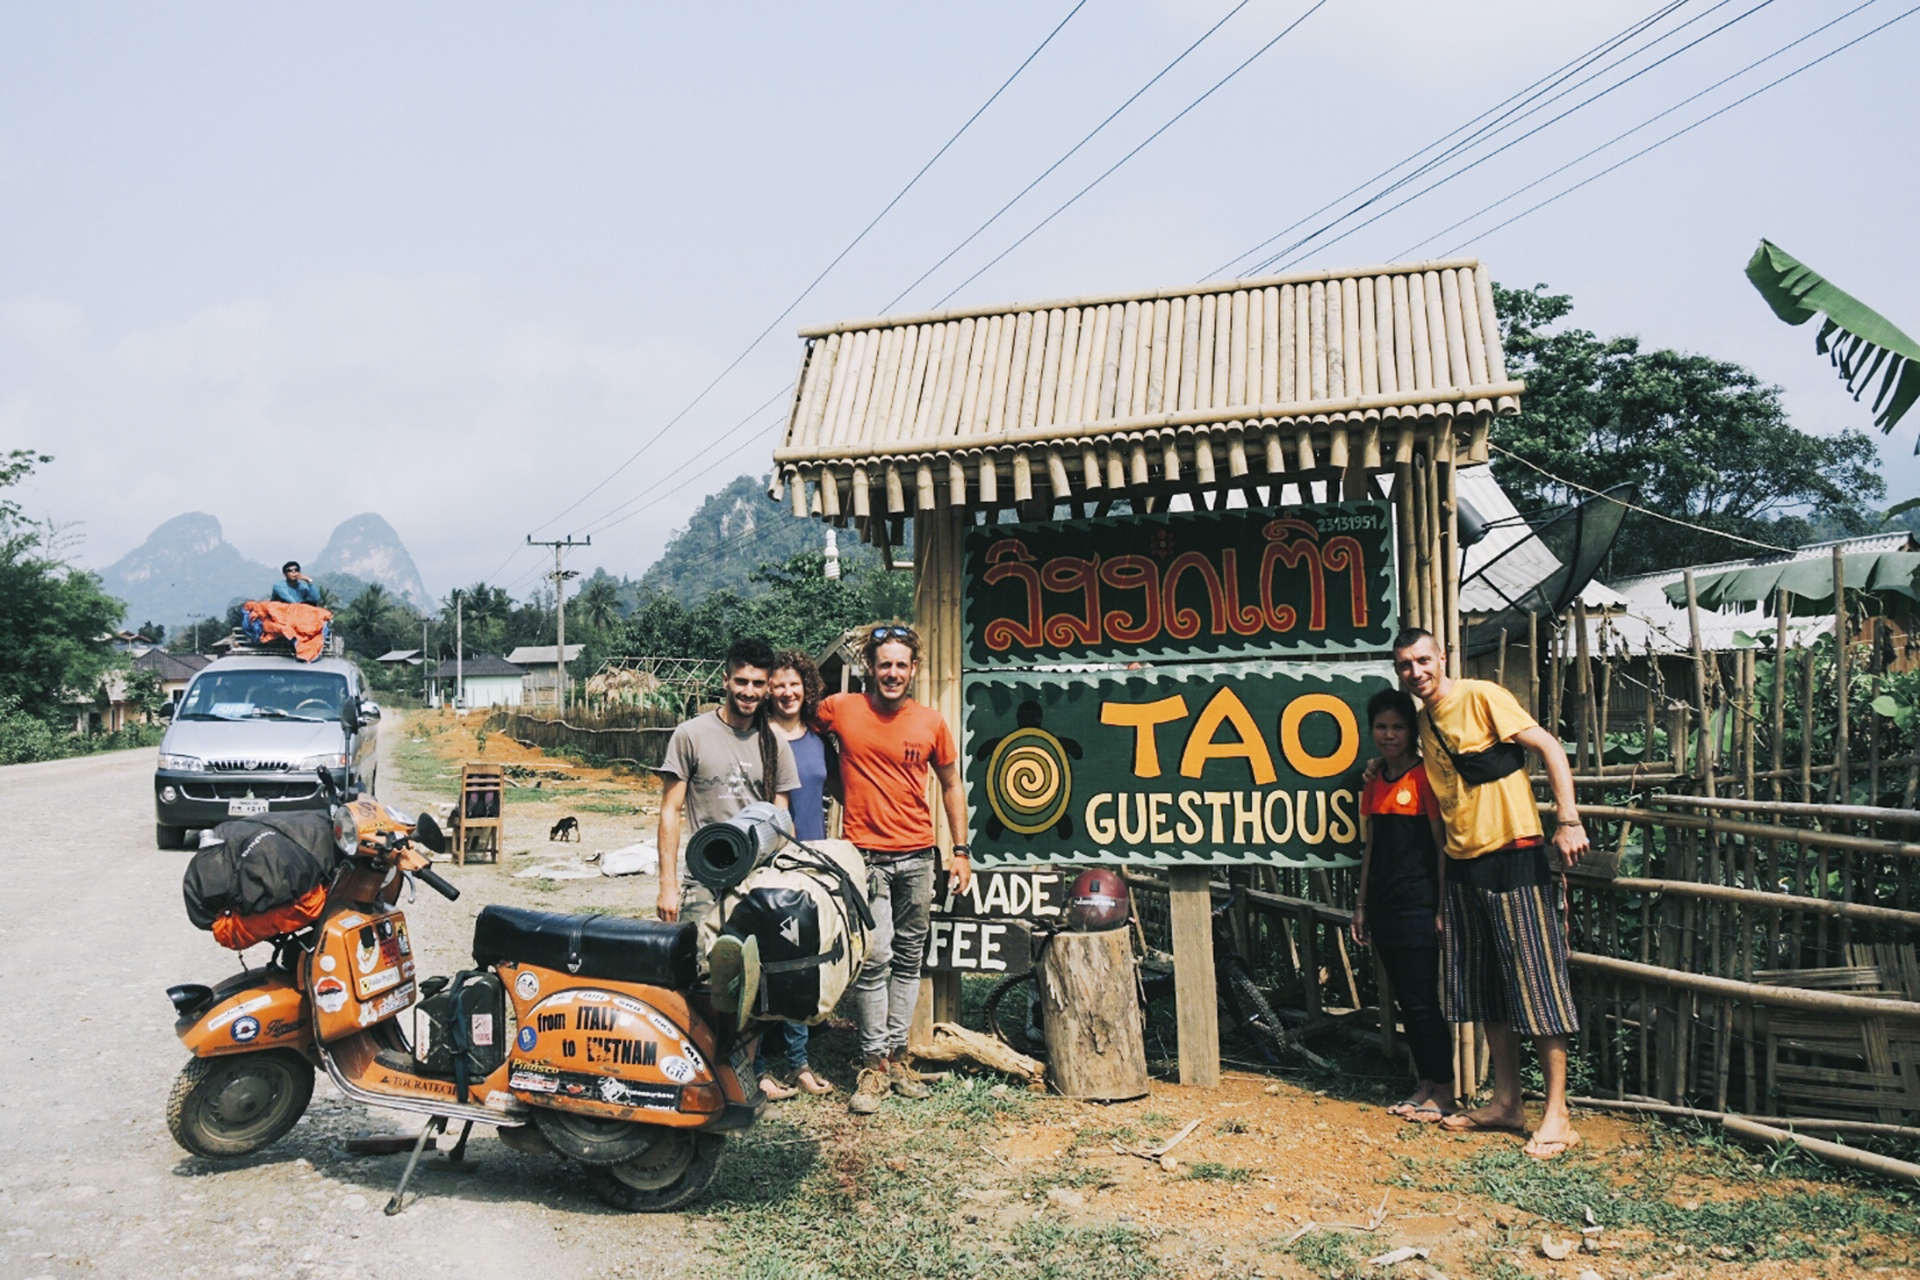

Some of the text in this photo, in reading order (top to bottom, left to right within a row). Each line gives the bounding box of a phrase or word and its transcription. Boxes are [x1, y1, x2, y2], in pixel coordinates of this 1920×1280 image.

[1317, 514, 1377, 532] 23131951
[1100, 685, 1360, 786] TAO
[537, 1012, 566, 1033] from
[576, 1006, 620, 1032] ITALY
[562, 1038, 576, 1057] to
[684, 1046, 702, 1067] MK
